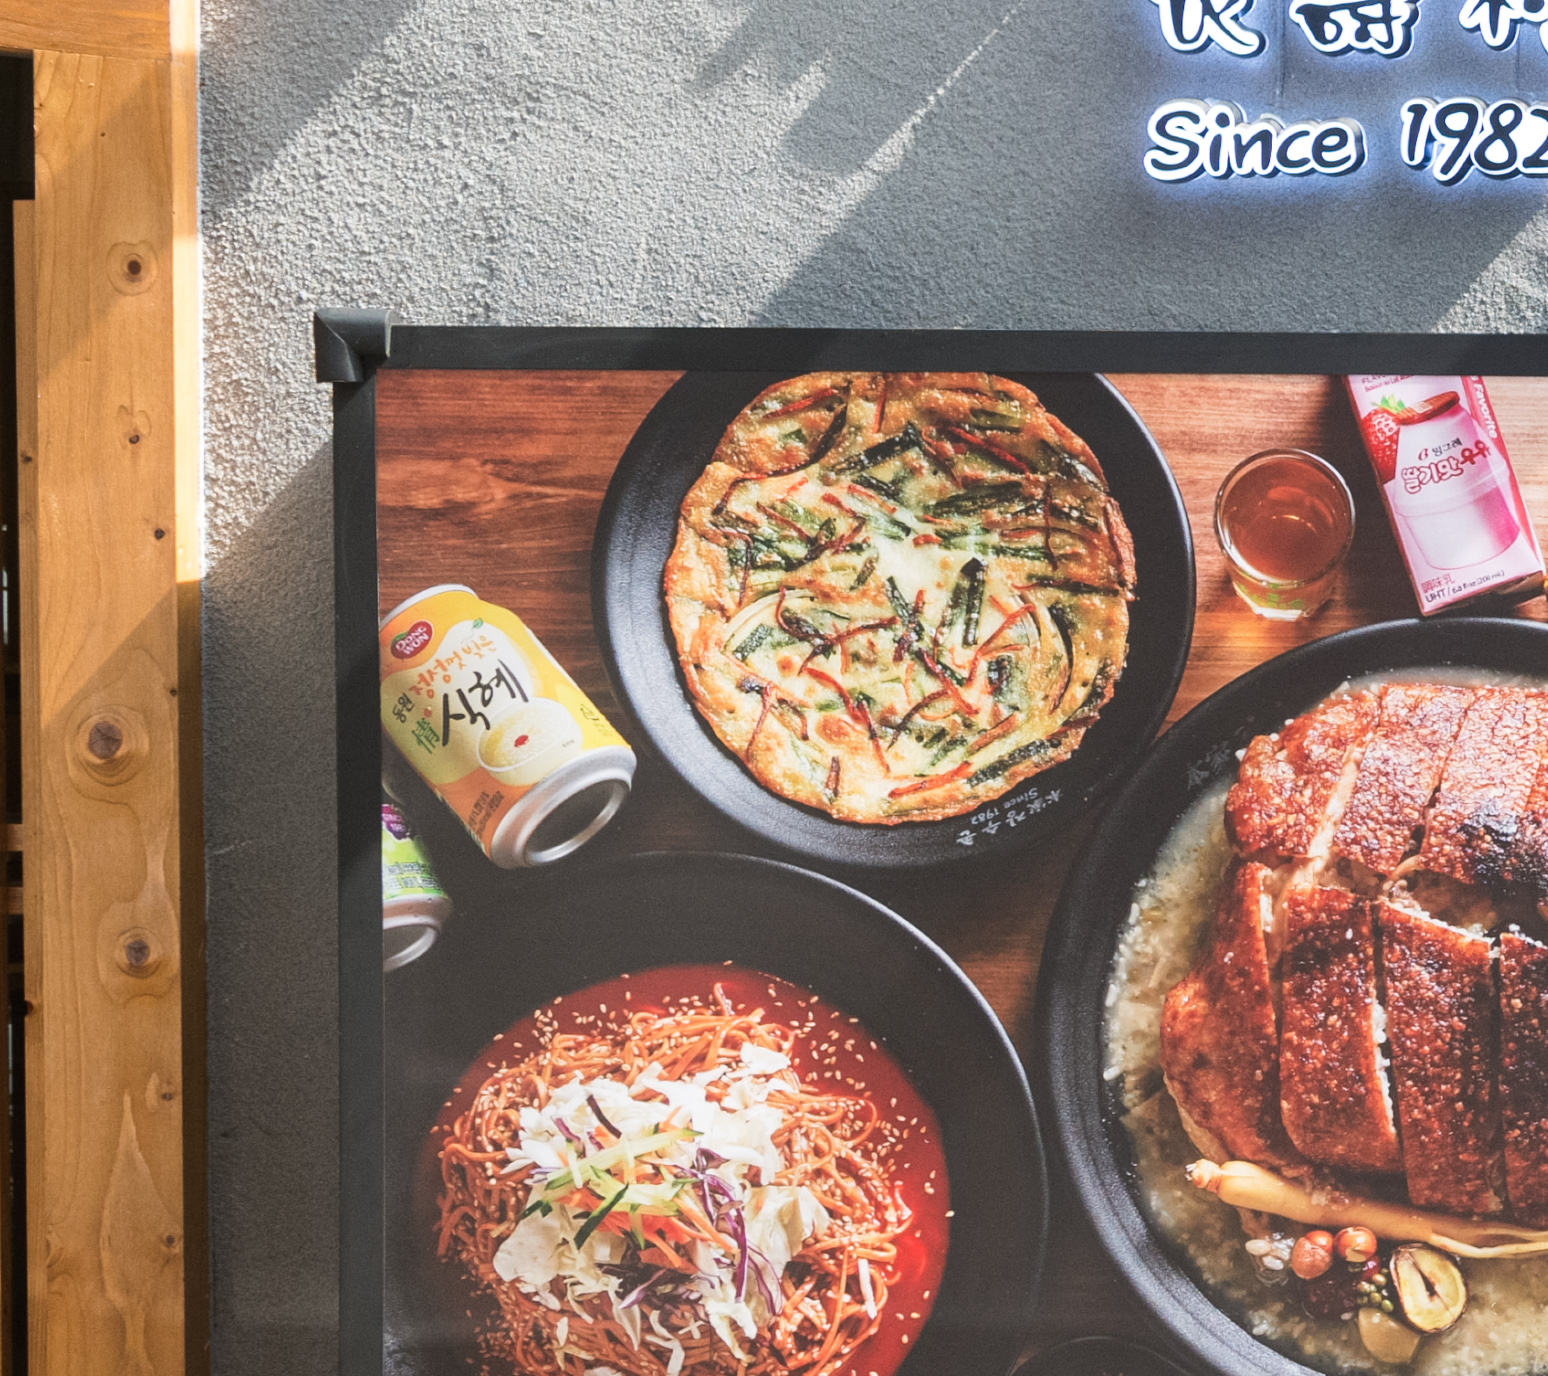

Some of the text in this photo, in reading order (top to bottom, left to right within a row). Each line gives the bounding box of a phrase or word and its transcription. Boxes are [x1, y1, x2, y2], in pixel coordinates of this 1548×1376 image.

[1143, 98, 1366, 183] Since
[1474, 384, 1498, 439] Favorite
[402, 635, 429, 655] WON
[442, 659, 529, 746] 식혜
